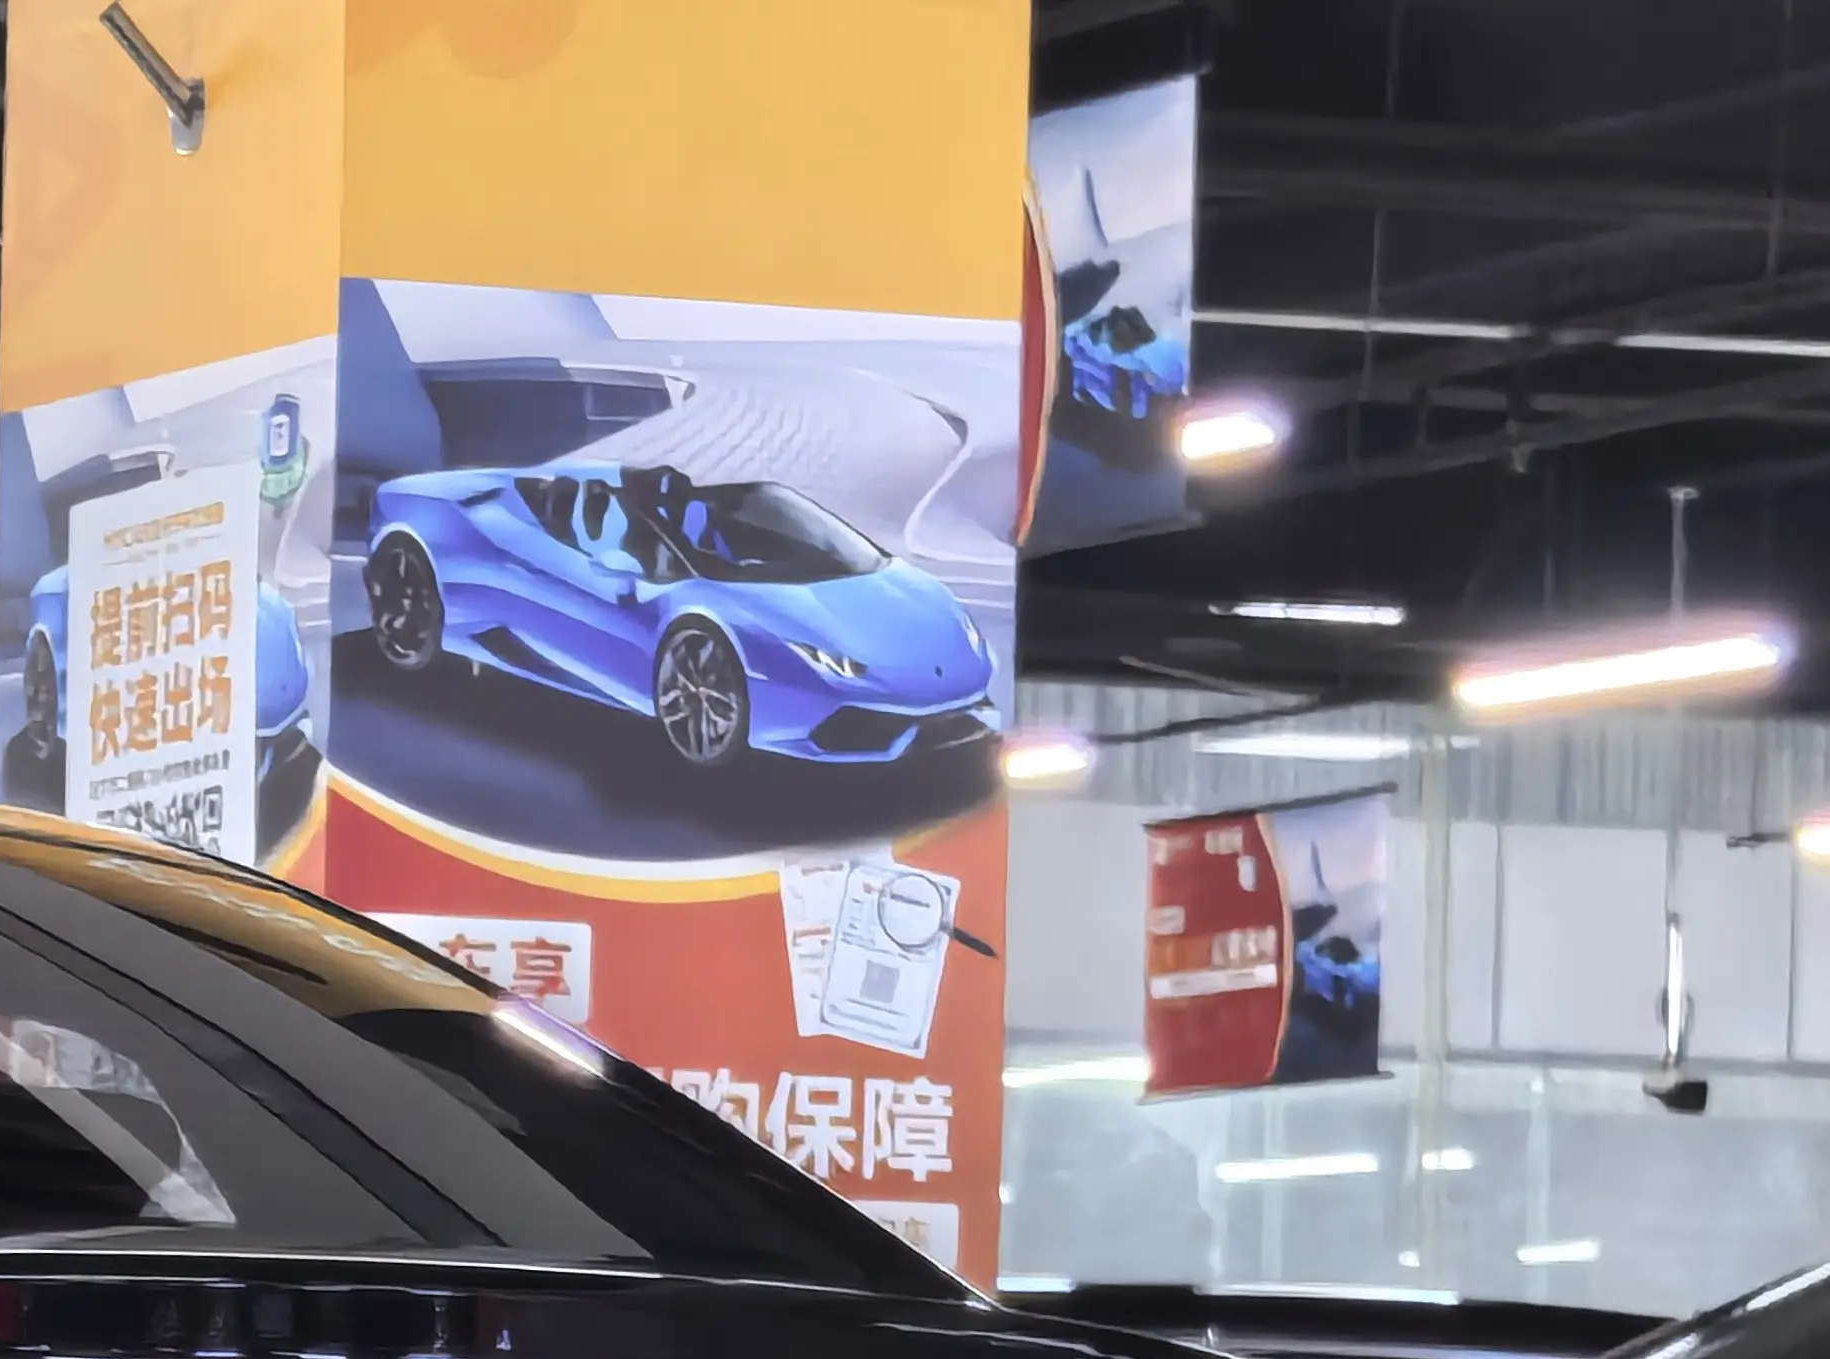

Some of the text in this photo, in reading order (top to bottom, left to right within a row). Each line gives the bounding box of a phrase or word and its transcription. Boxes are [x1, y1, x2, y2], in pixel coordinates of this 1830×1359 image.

[90, 559, 232, 670] 提前扫码
[89, 655, 232, 766] 快速出场
[644, 1067, 954, 1183] 购保障
